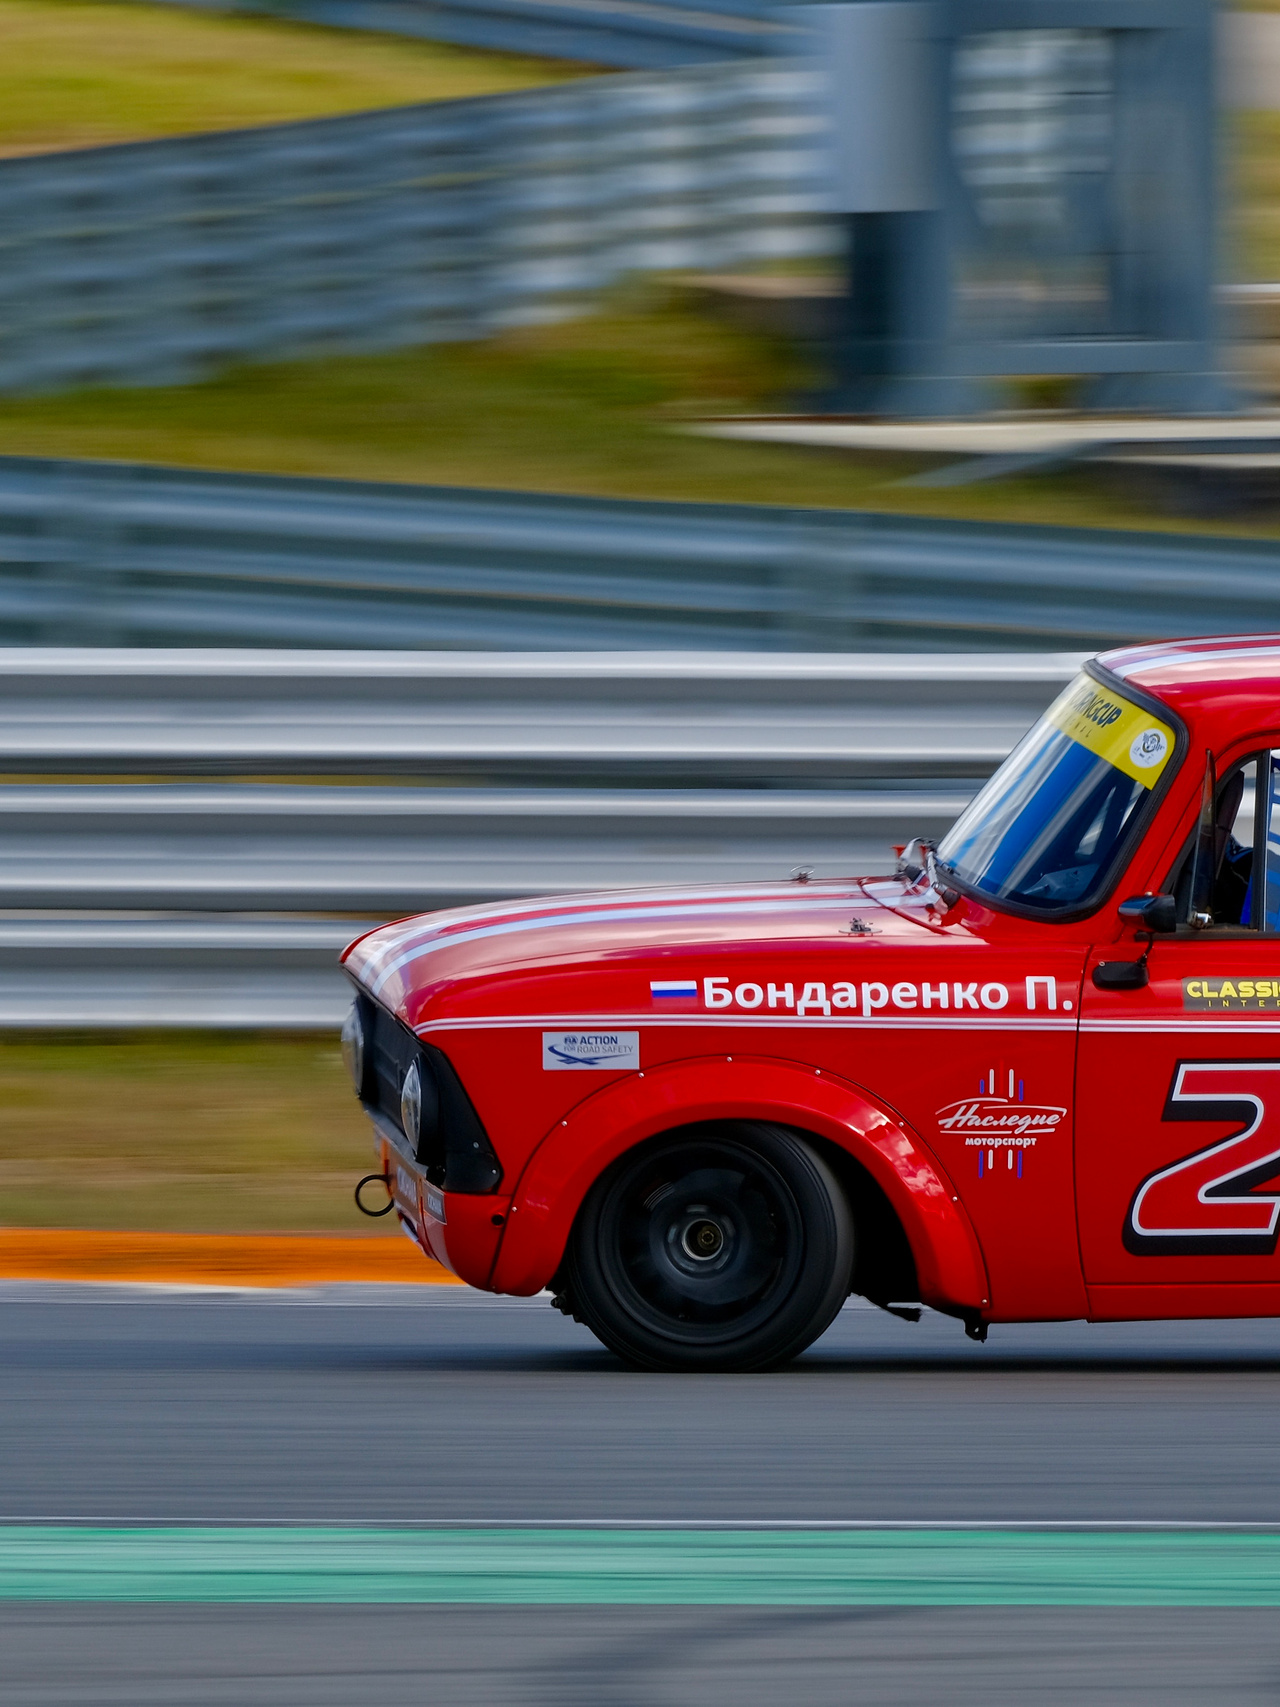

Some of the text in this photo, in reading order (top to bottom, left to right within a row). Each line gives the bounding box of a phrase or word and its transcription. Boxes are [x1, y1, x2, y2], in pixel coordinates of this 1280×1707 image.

[703, 975, 1073, 1017] Бондаренко П.
[580, 1036, 618, 1045] ACTION
[577, 1045, 600, 1053] ROAD
[602, 1045, 633, 1053] SAFETY
[938, 1103, 1061, 1134] Наследие
[965, 1138, 1037, 1148] моторспорт
